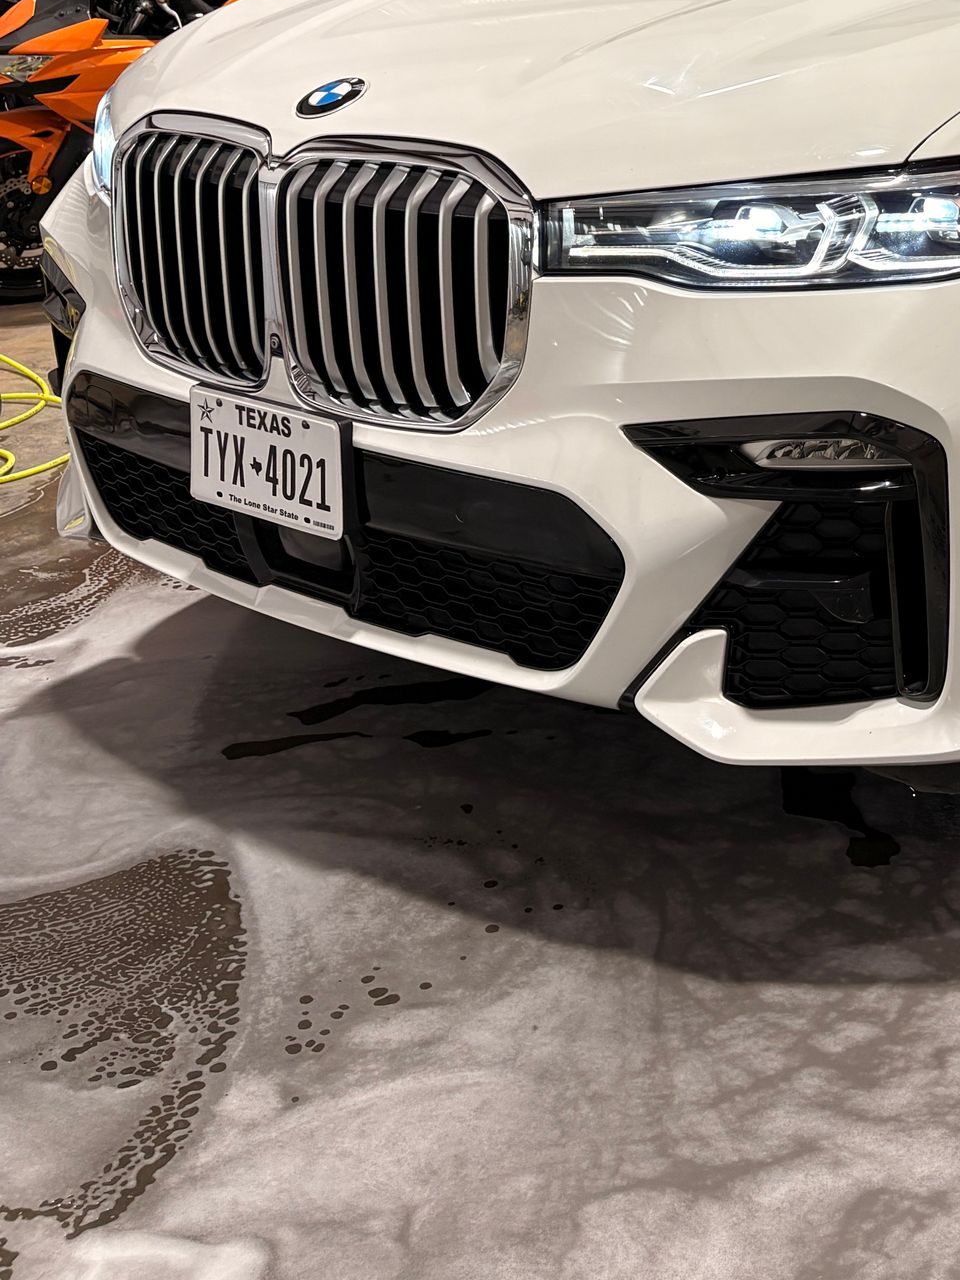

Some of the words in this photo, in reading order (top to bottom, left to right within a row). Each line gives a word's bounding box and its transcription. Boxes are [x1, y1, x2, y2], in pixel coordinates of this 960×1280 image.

[234, 404, 292, 438] TEXAS
[200, 426, 246, 488] TYX
[265, 444, 331, 513] 4021
[228, 493, 243, 504] The
[243, 498, 261, 509] Lone
[262, 503, 278, 514] Star
[279, 508, 299, 521] State
